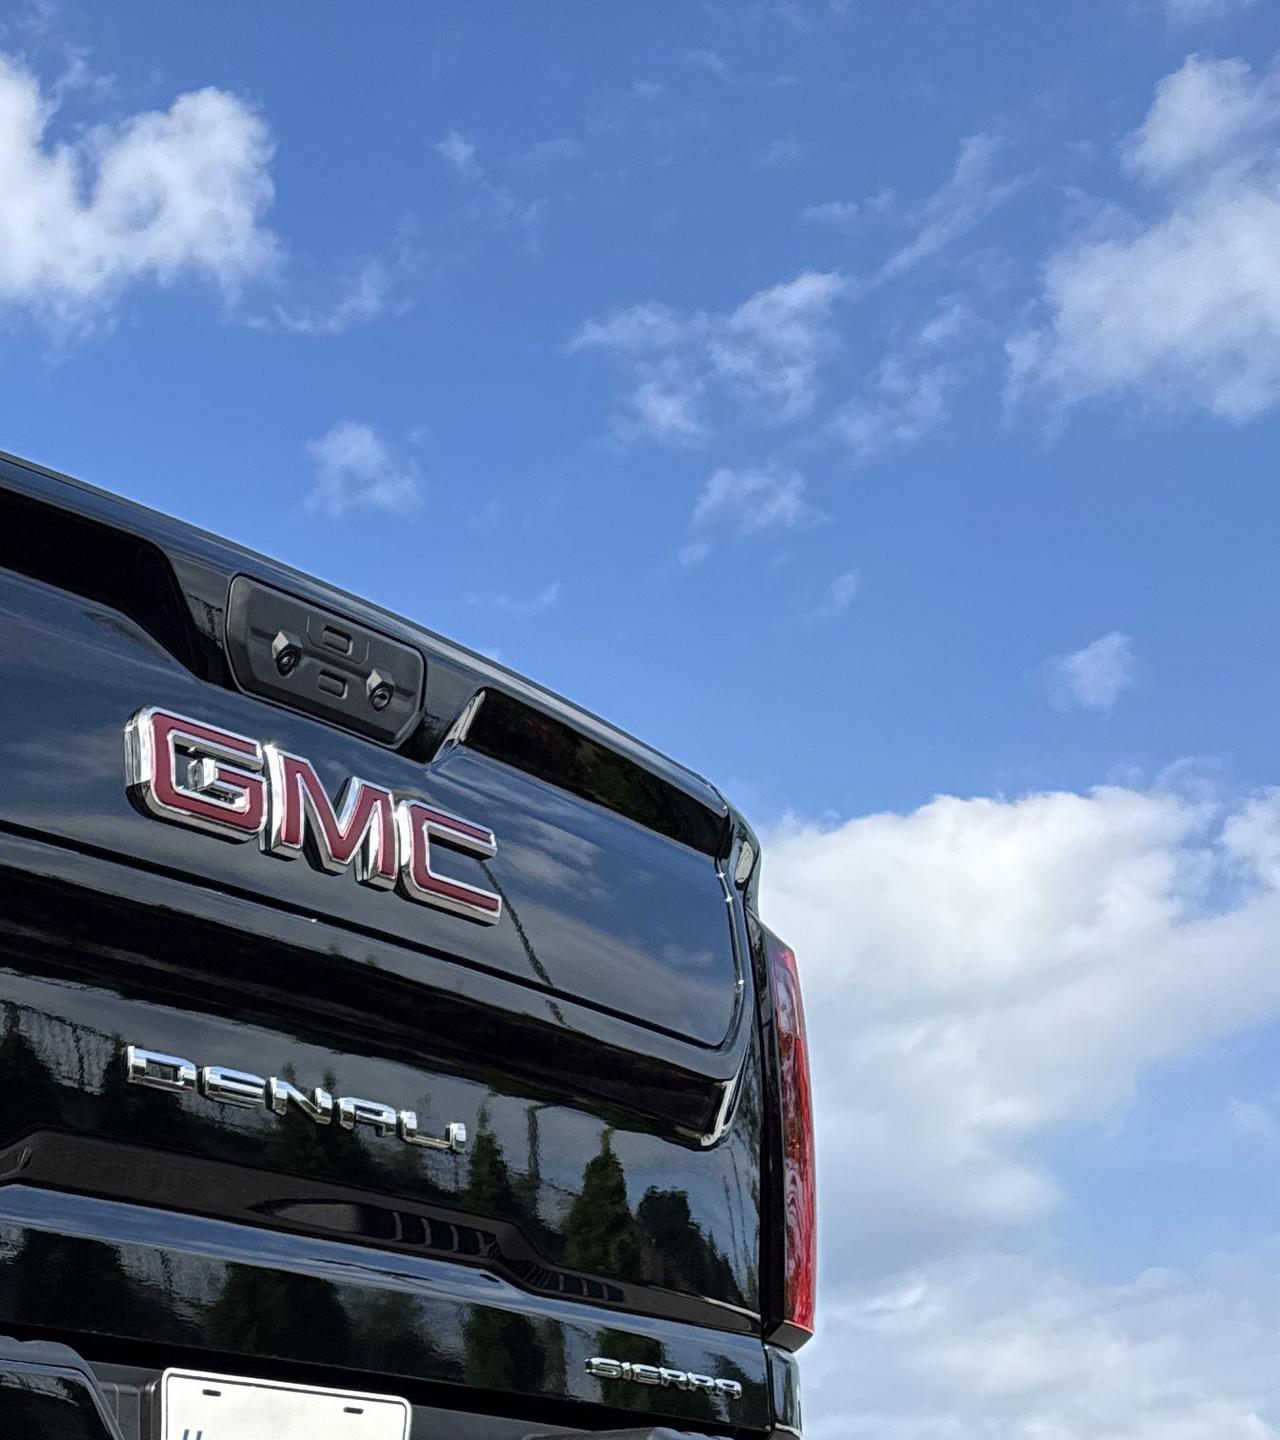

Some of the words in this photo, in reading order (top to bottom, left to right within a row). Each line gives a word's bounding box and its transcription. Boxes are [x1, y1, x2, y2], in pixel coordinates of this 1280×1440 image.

[123, 705, 502, 925] GMC
[126, 1045, 466, 1153] DENALI
[585, 1357, 742, 1399] SIERRA
